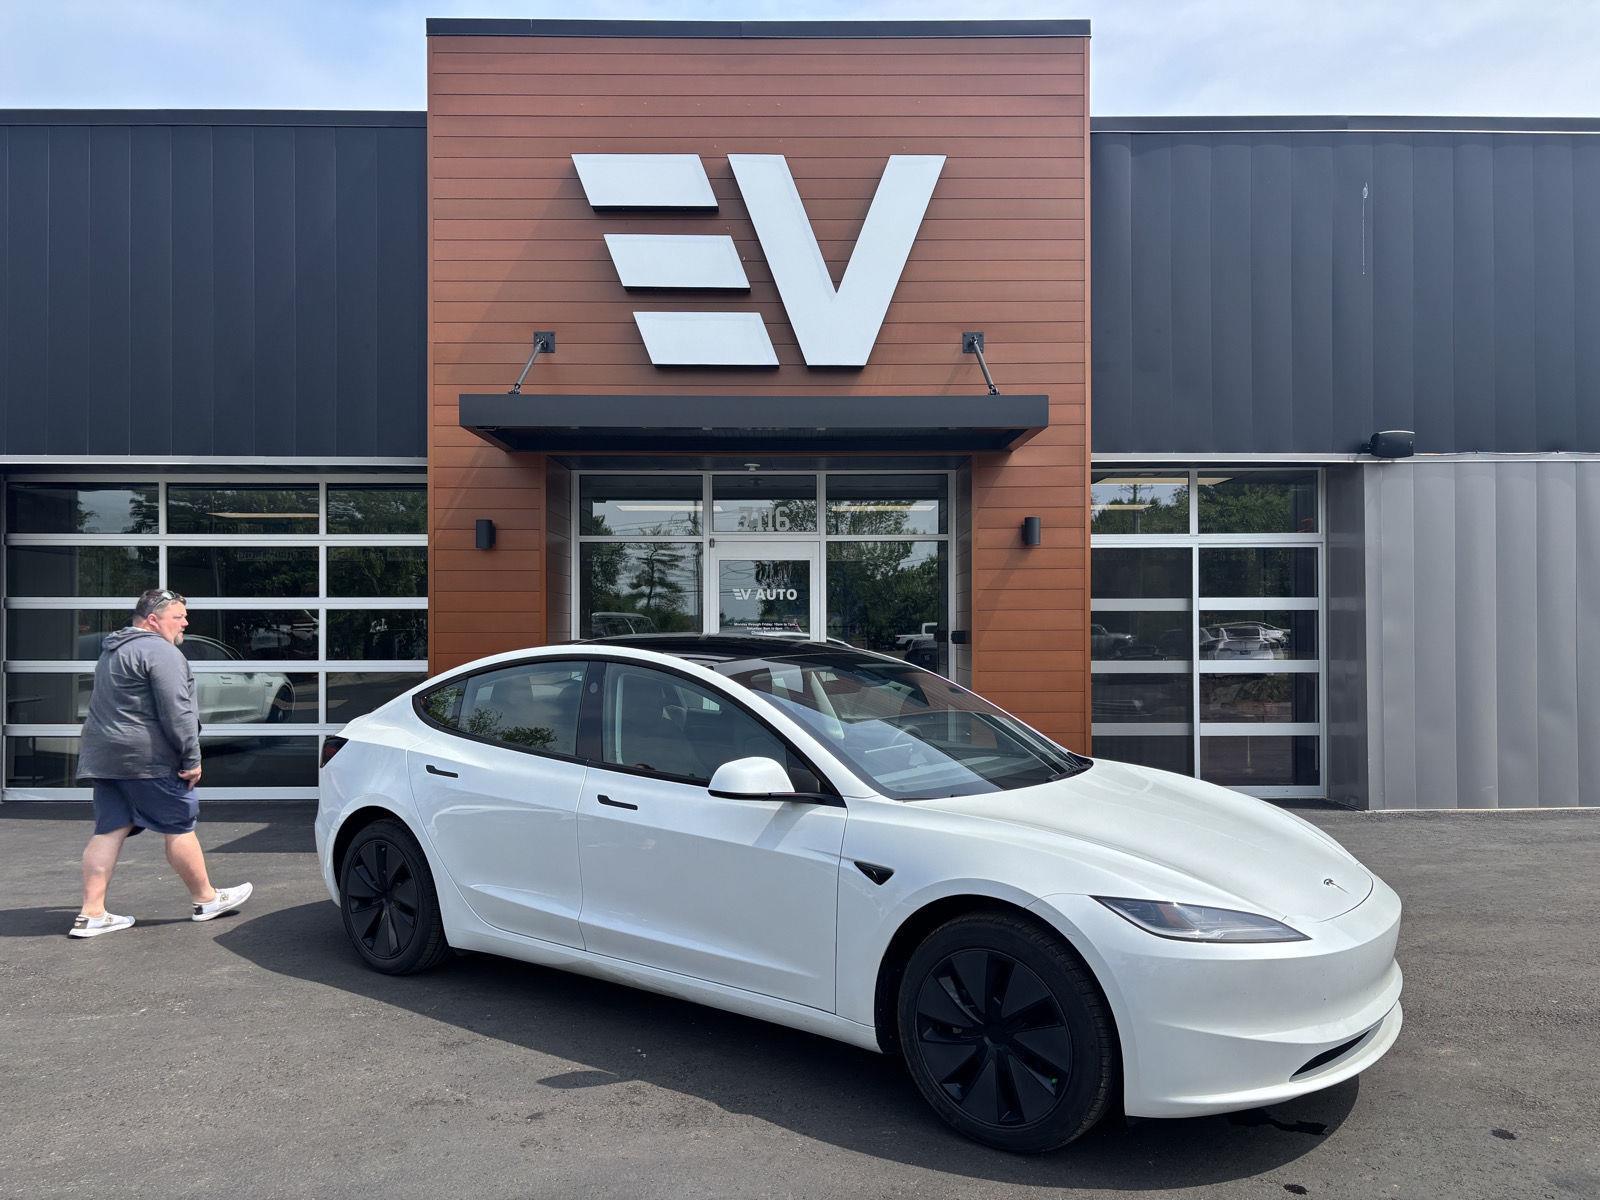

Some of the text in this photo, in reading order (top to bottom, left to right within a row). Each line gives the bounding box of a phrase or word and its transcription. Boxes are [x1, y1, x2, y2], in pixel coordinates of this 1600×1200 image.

[571, 153, 947, 367] EV
[732, 588, 798, 600] EV AUTO
